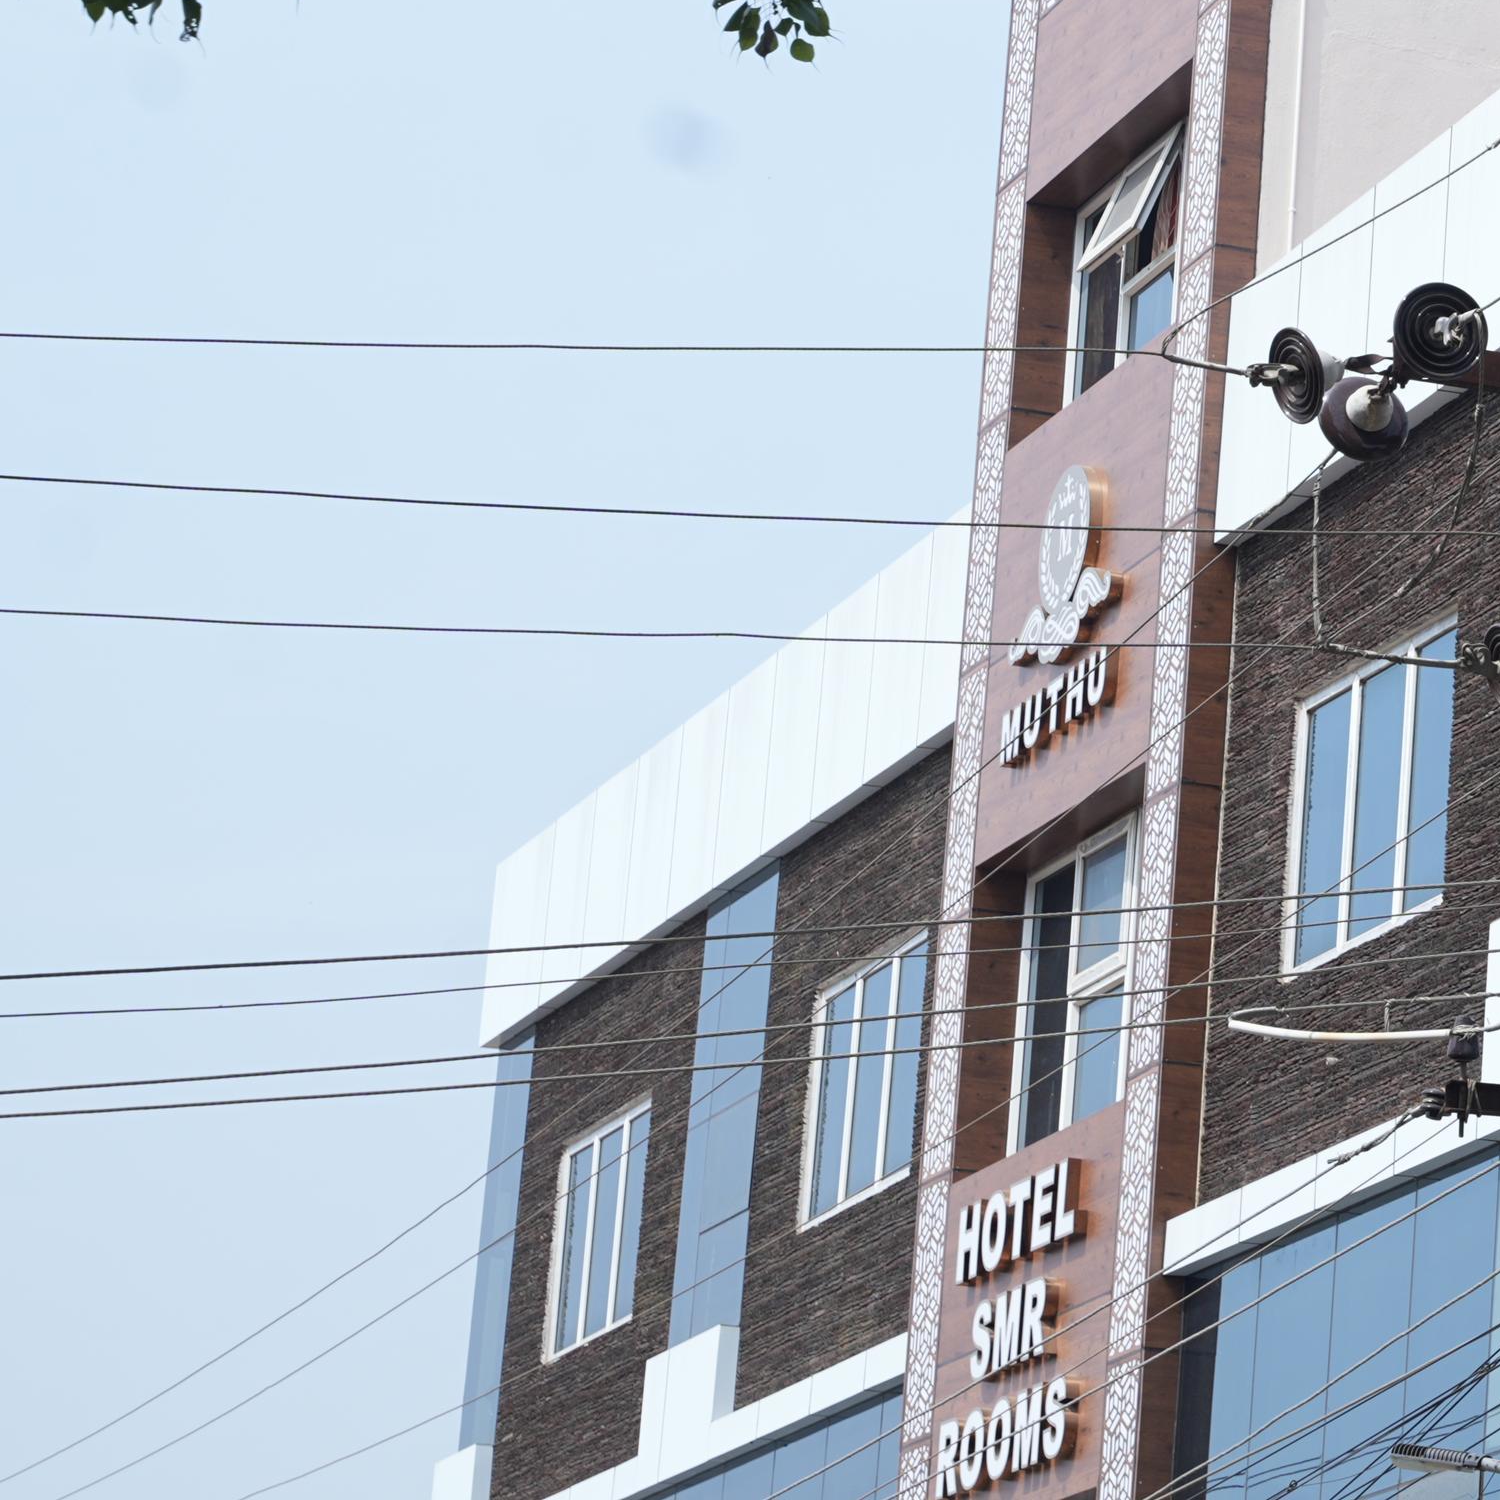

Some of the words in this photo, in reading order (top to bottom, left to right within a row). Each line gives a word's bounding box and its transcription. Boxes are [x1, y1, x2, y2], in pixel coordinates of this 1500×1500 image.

[1000, 645, 1108, 768] MUTHU
[956, 1157, 1077, 1286] HOTEL
[970, 1276, 1048, 1382] SMR
[935, 1375, 1067, 1499] ROOMS
